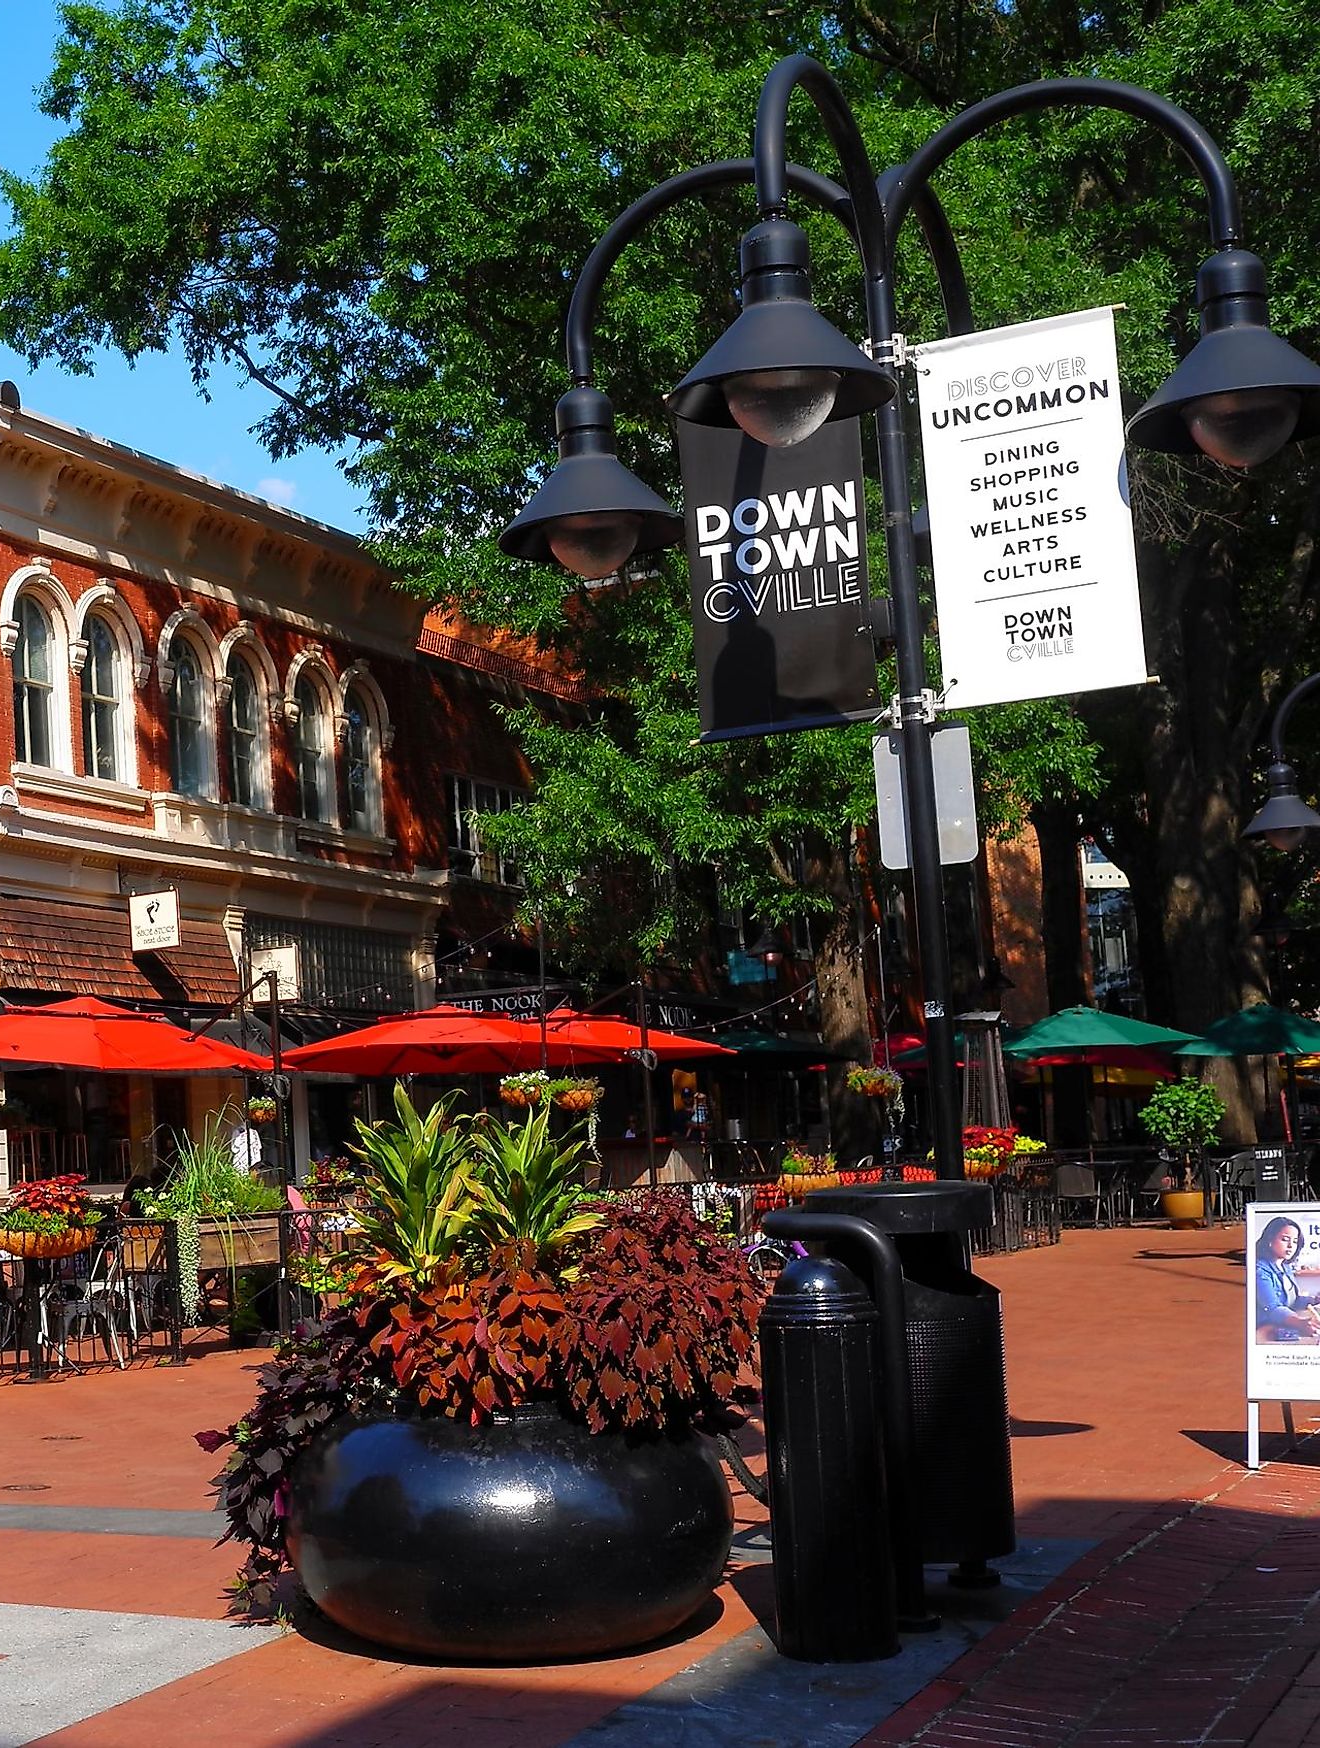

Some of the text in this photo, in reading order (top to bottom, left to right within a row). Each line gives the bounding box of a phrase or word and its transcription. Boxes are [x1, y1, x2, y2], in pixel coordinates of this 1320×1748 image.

[947, 356, 1087, 401] DISCOVER
[931, 379, 1110, 430] UNCOMMON
[984, 440, 1060, 466] DINING
[970, 460, 1080, 492] SHOPPING
[695, 480, 858, 544] DOWN
[993, 487, 1060, 511] MUSIC
[970, 506, 1087, 538] WELLNESS
[699, 520, 860, 582] TOWN
[1002, 535, 1059, 557] ARTS
[983, 555, 1082, 583] CULTURE
[703, 560, 862, 623] CVILLE
[1004, 605, 1072, 629] DOWN
[1005, 621, 1073, 644] TOWN
[1006, 637, 1074, 662] CVILLE
[451, 994, 543, 1013] THE NOOK
